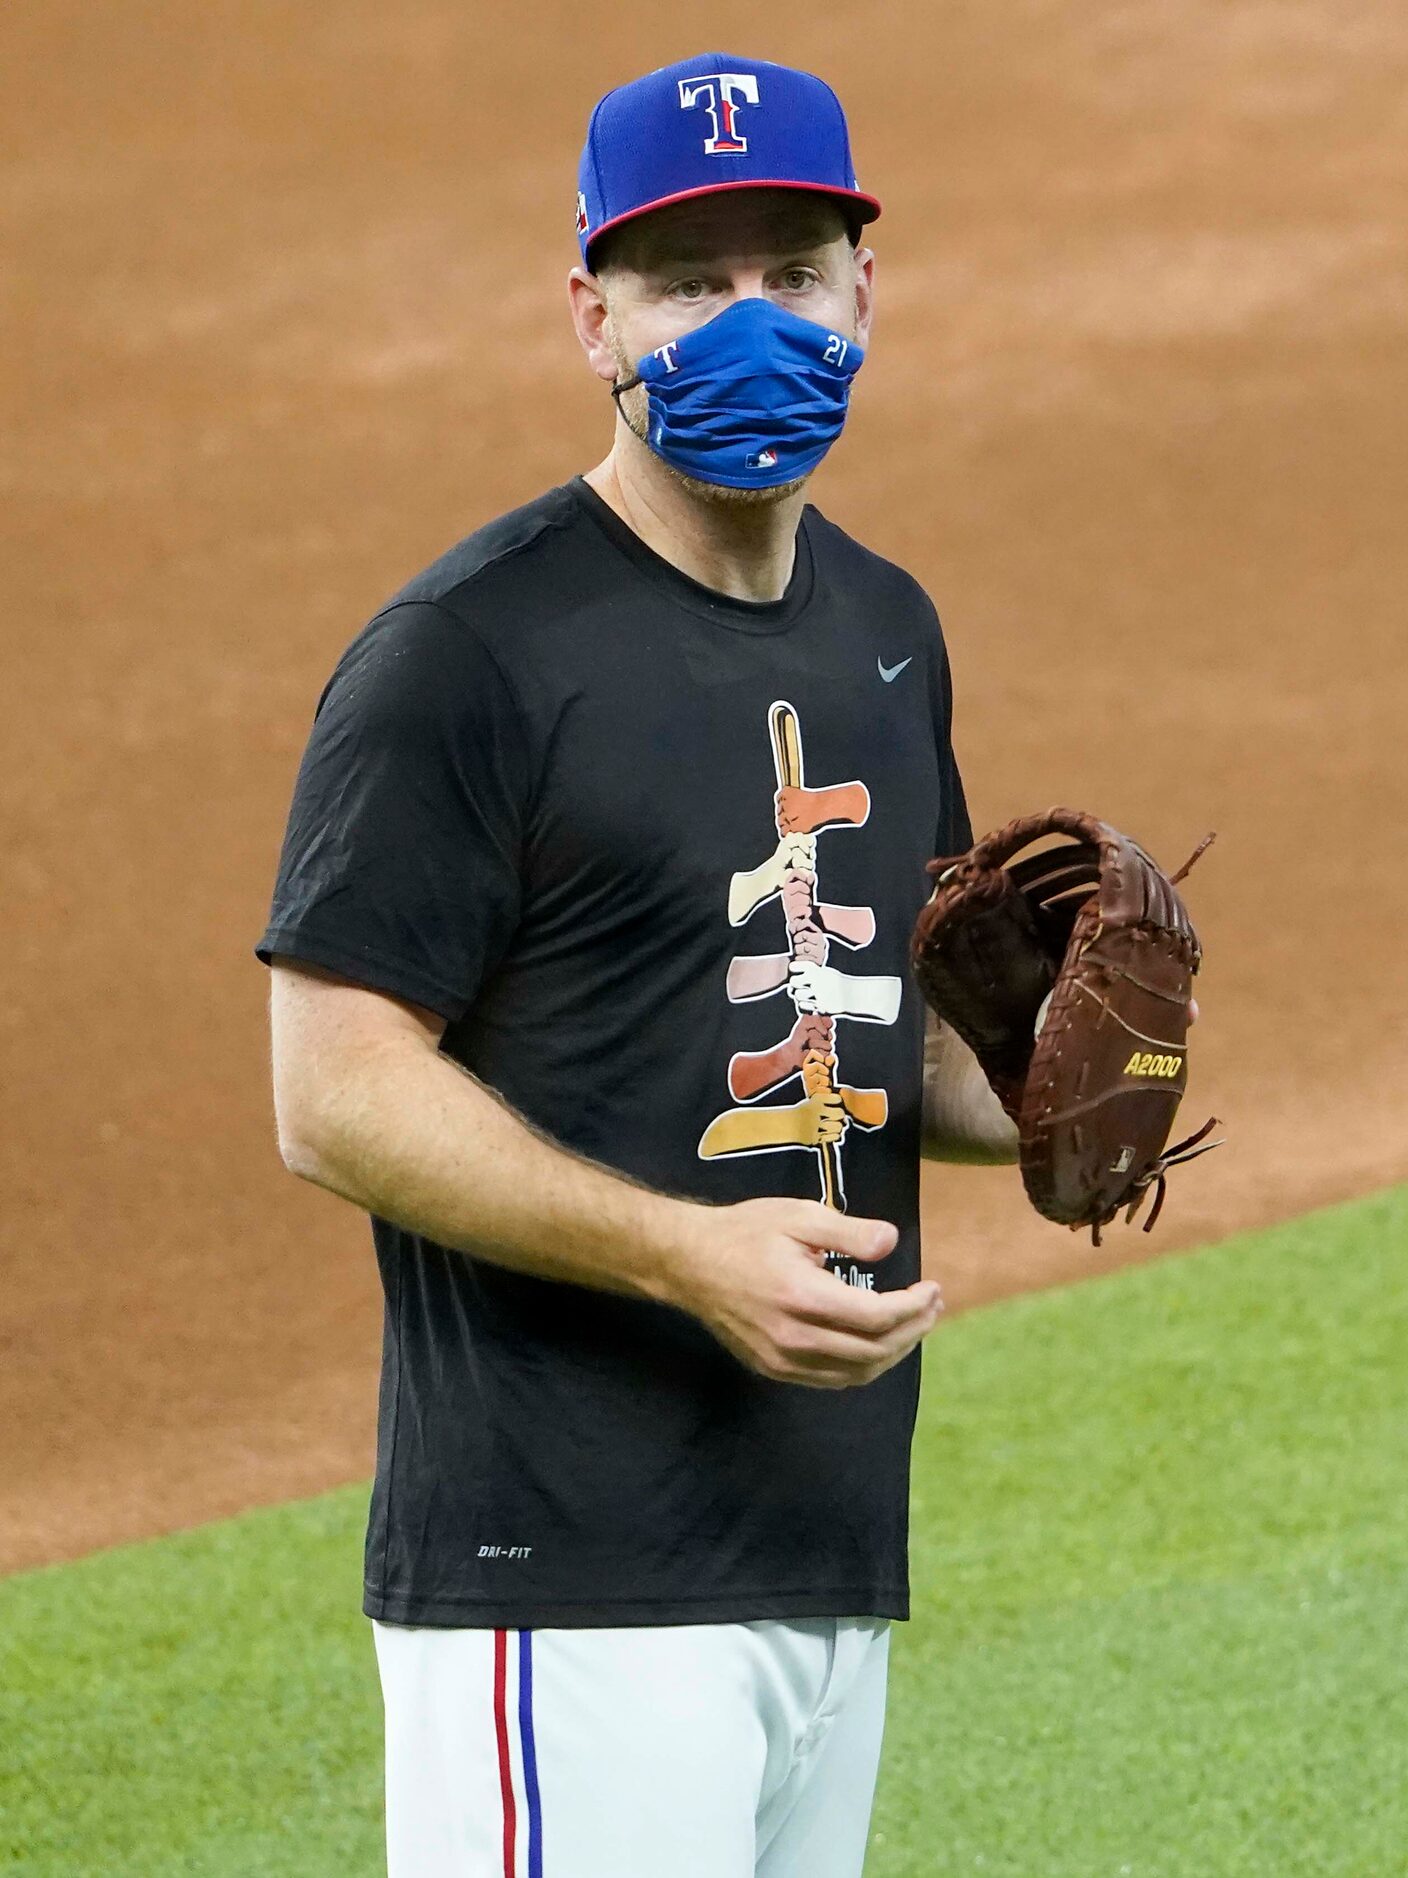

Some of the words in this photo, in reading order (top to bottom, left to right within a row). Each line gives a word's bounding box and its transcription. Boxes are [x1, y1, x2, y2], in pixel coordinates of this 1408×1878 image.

[678, 73, 760, 155] T
[654, 341, 680, 374] T
[822, 334, 848, 367] 21
[1123, 1052, 1183, 1078] A2000
[477, 1545, 533, 1559] DRI-FIT
